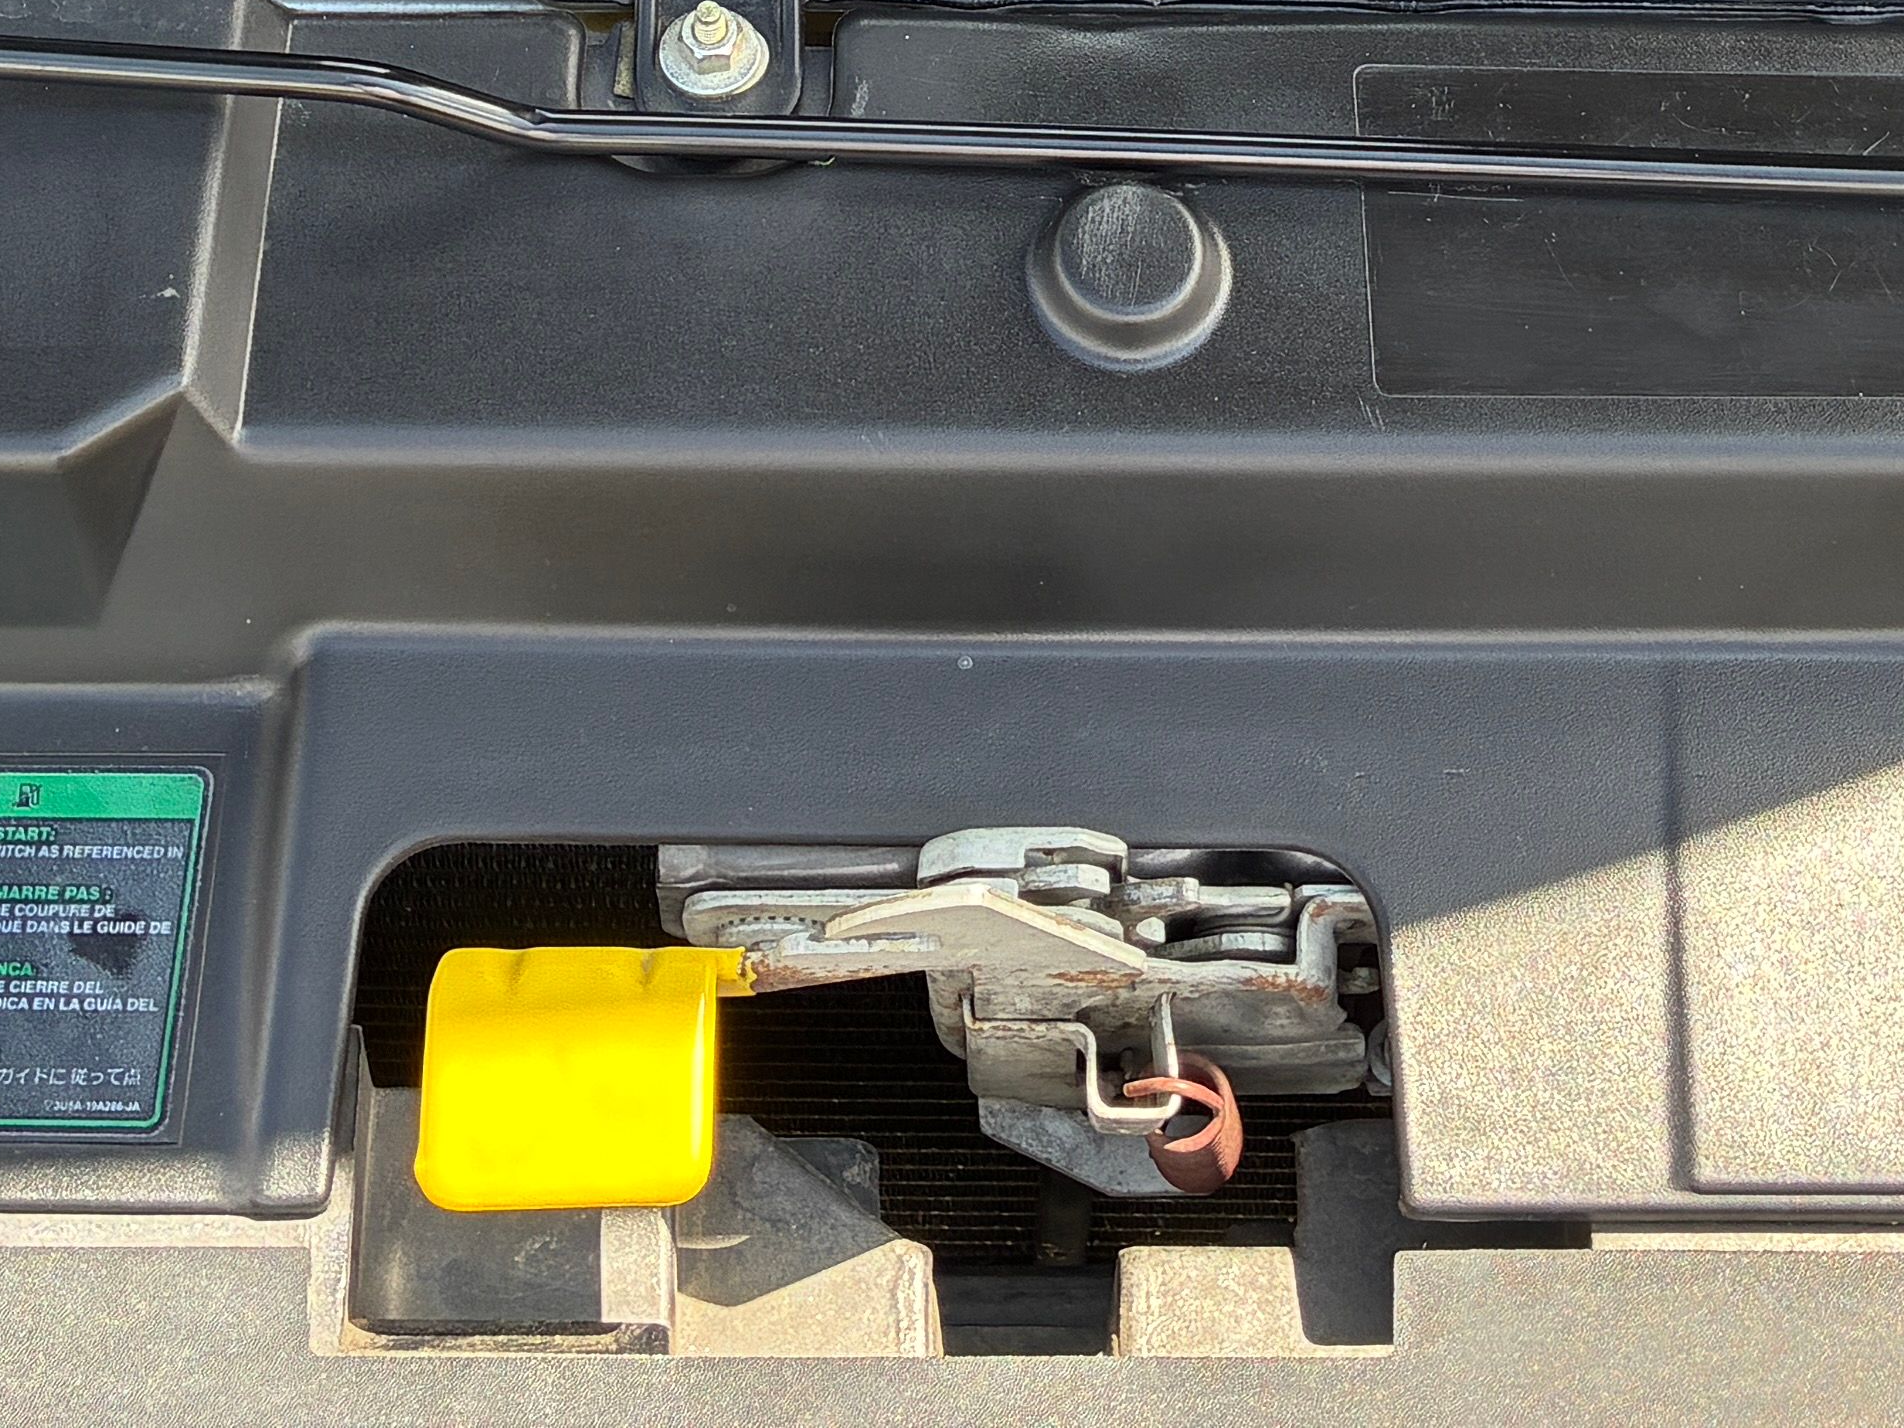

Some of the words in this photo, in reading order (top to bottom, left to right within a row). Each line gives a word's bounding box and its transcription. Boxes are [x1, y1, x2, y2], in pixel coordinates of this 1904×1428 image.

[38, 845, 59, 857] AS
[63, 845, 163, 858] REFERENCED
[167, 846, 183, 858] IN
[64, 885, 105, 899] PAS
[14, 904, 89, 916] COUPURE
[93, 904, 115, 917] DE
[26, 920, 69, 933] DANS
[73, 920, 93, 933] LE
[97, 921, 145, 933] GUIDE
[149, 921, 175, 933] DE
[9, 980, 68, 993] CIERRE
[73, 981, 103, 993] DEL
[32, 997, 54, 1009] EN
[59, 997, 79, 1010] LA
[126, 998, 158, 1011] DEL
